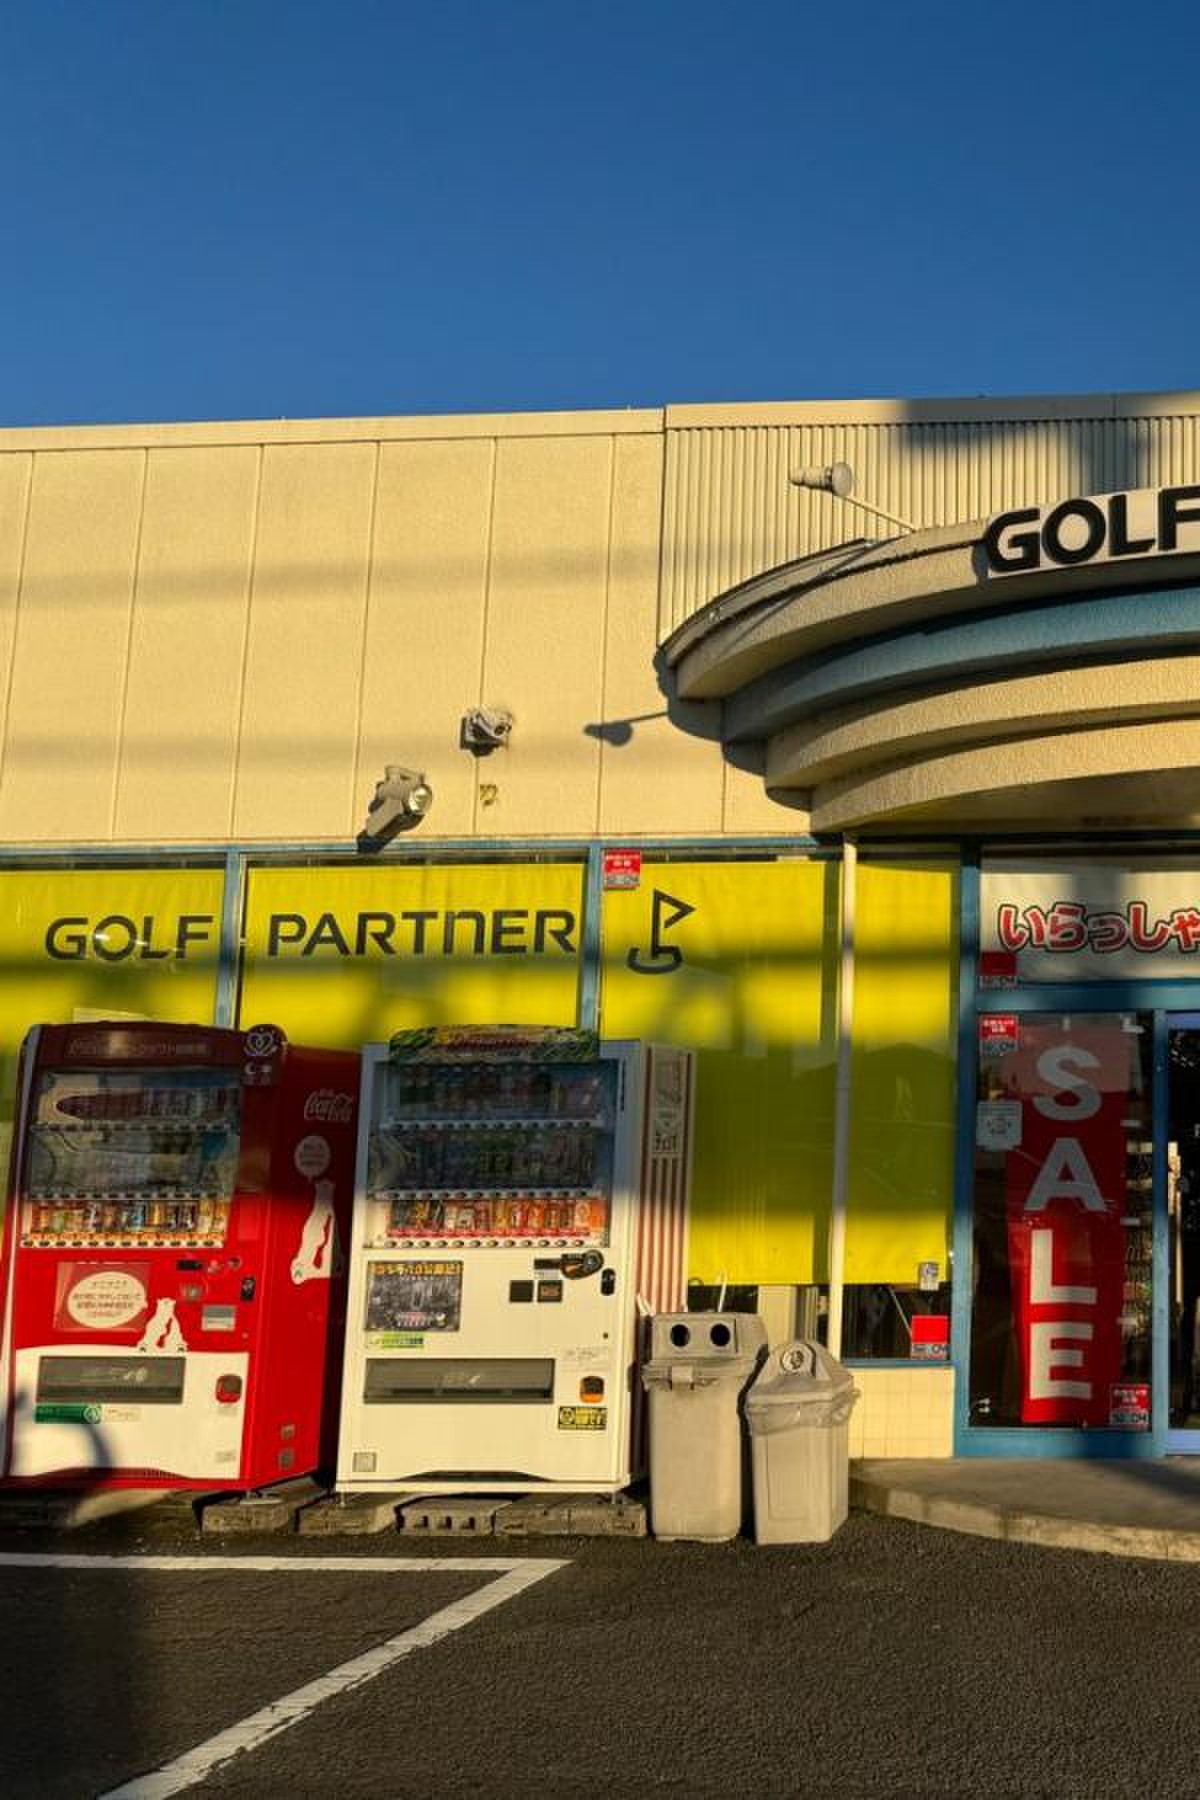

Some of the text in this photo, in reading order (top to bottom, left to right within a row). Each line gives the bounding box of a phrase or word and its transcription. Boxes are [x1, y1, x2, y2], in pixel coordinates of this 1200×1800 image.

[45, 908, 577, 962] GOLF PARTNER
[1024, 1044, 1107, 1400] SALE
